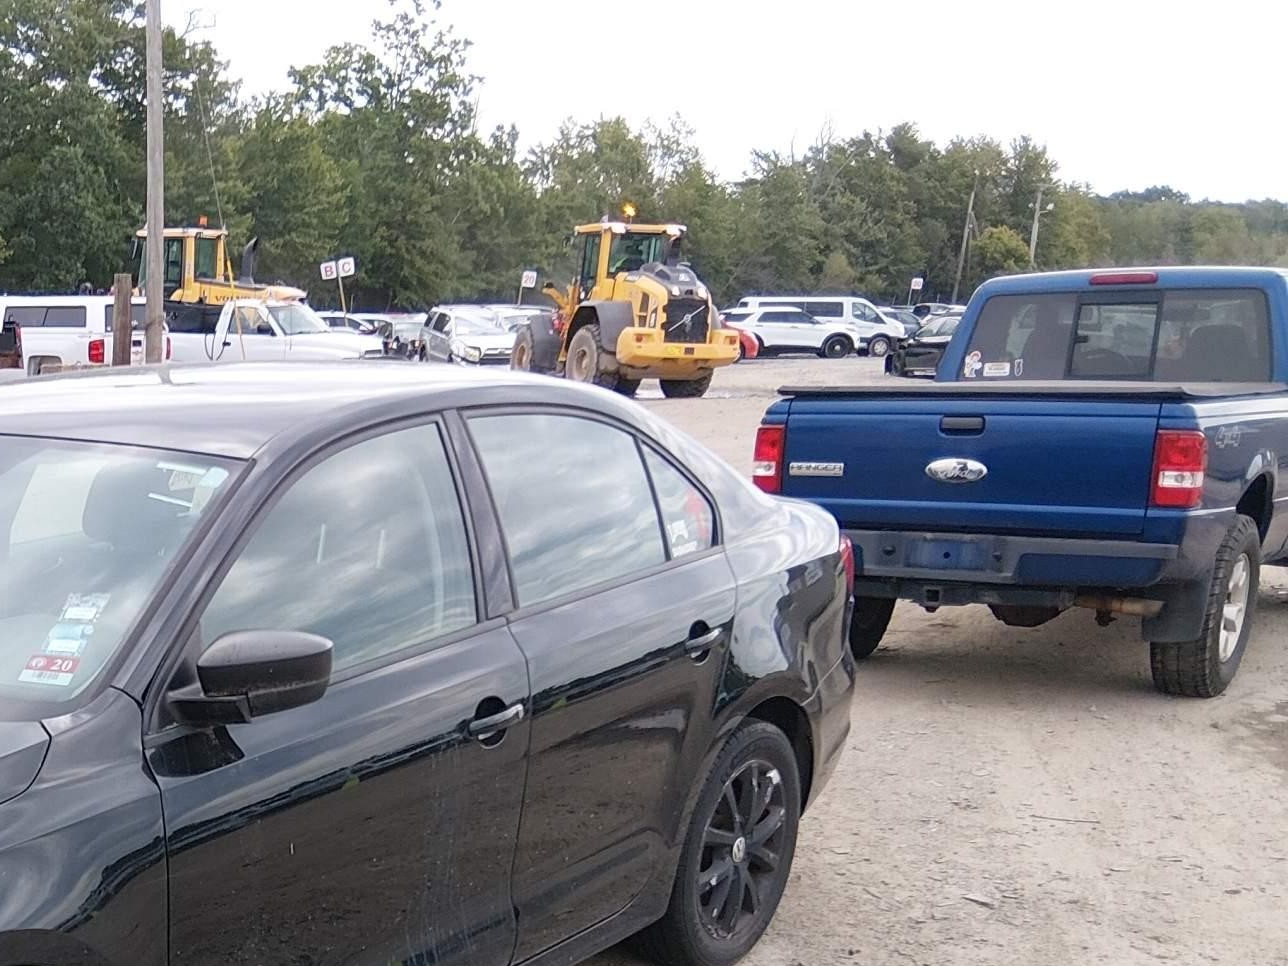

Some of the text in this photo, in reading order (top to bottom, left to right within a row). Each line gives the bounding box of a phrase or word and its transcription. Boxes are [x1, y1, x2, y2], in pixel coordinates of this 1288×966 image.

[324, 261, 352, 278] B C
[523, 274, 535, 286] 20
[790, 463, 843, 473] RANGER
